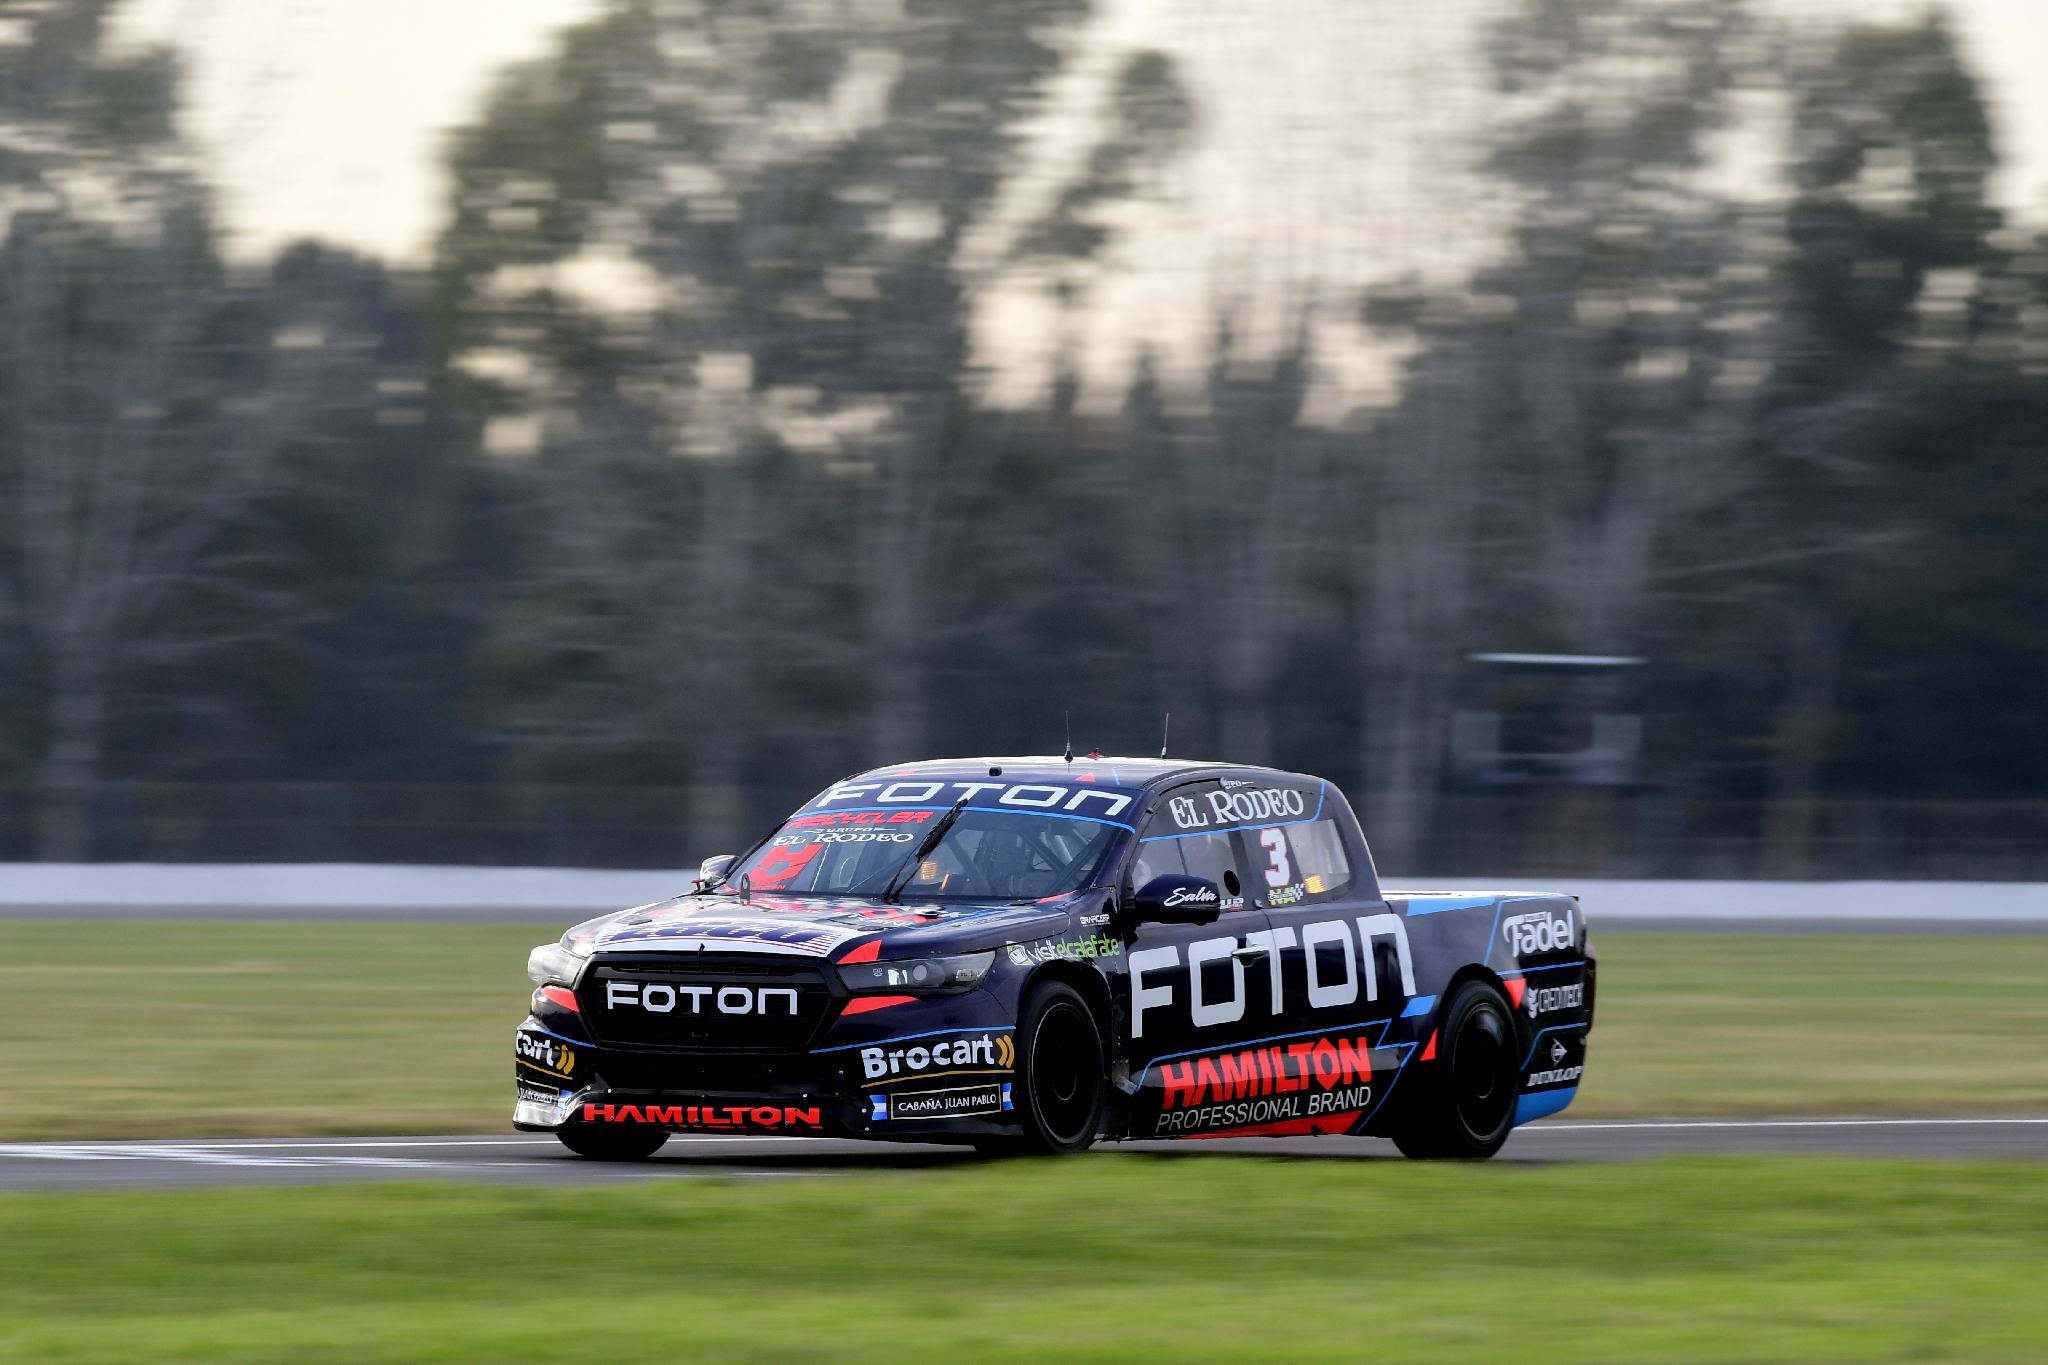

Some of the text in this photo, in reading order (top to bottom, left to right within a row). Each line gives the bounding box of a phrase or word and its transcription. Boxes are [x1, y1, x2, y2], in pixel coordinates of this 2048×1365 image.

[816, 782, 1132, 816] FOTON
[1169, 789, 1304, 828] EL RODEO
[773, 833, 914, 846] EL RODEO
[1260, 827, 1291, 887] 3
[1502, 909, 1574, 957] Fadel
[1129, 914, 1416, 1038] FOTON
[607, 982, 797, 1015] FOTON
[861, 1034, 994, 1078] Brocart
[1161, 1037, 1372, 1109] HAMILTON
[584, 1104, 820, 1125] HAMILTON
[898, 1094, 996, 1111] CABAÑA JUAN PABLO
[1156, 1086, 1371, 1132] PROFESSIONAL BRAND
